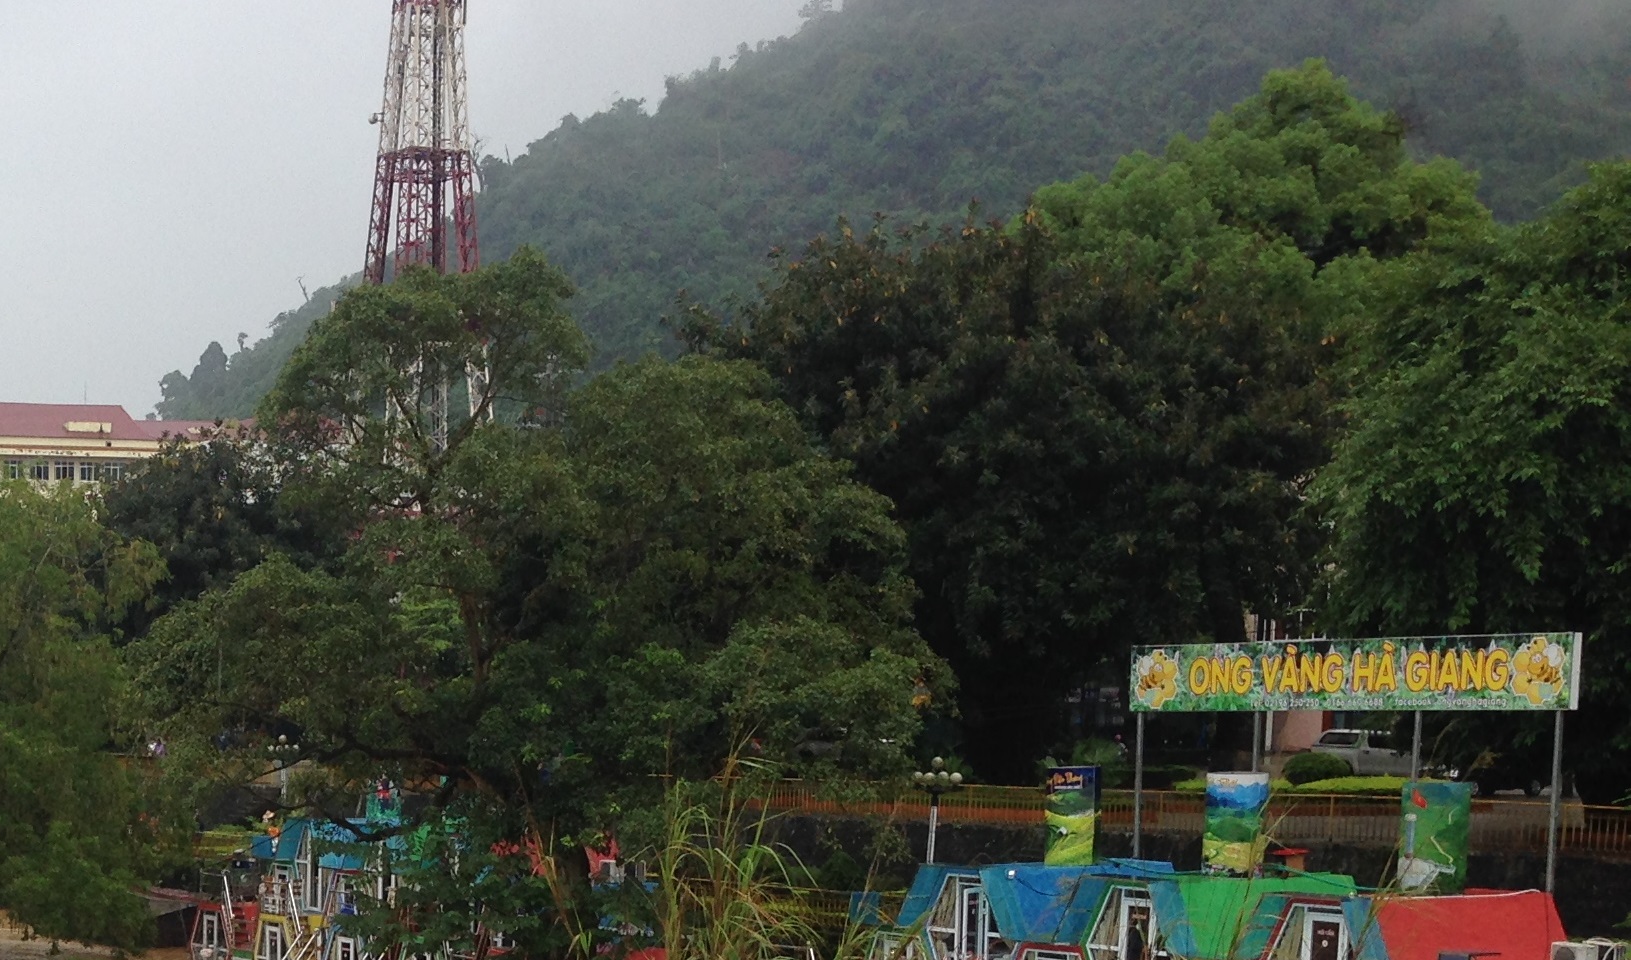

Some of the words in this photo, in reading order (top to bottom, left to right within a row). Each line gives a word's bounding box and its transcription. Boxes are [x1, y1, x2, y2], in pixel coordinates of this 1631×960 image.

[1189, 655, 1253, 695] ONG
[1262, 643, 1345, 693] VÀNG
[1352, 641, 1396, 692] HÀ
[1405, 648, 1509, 692] GIANG
